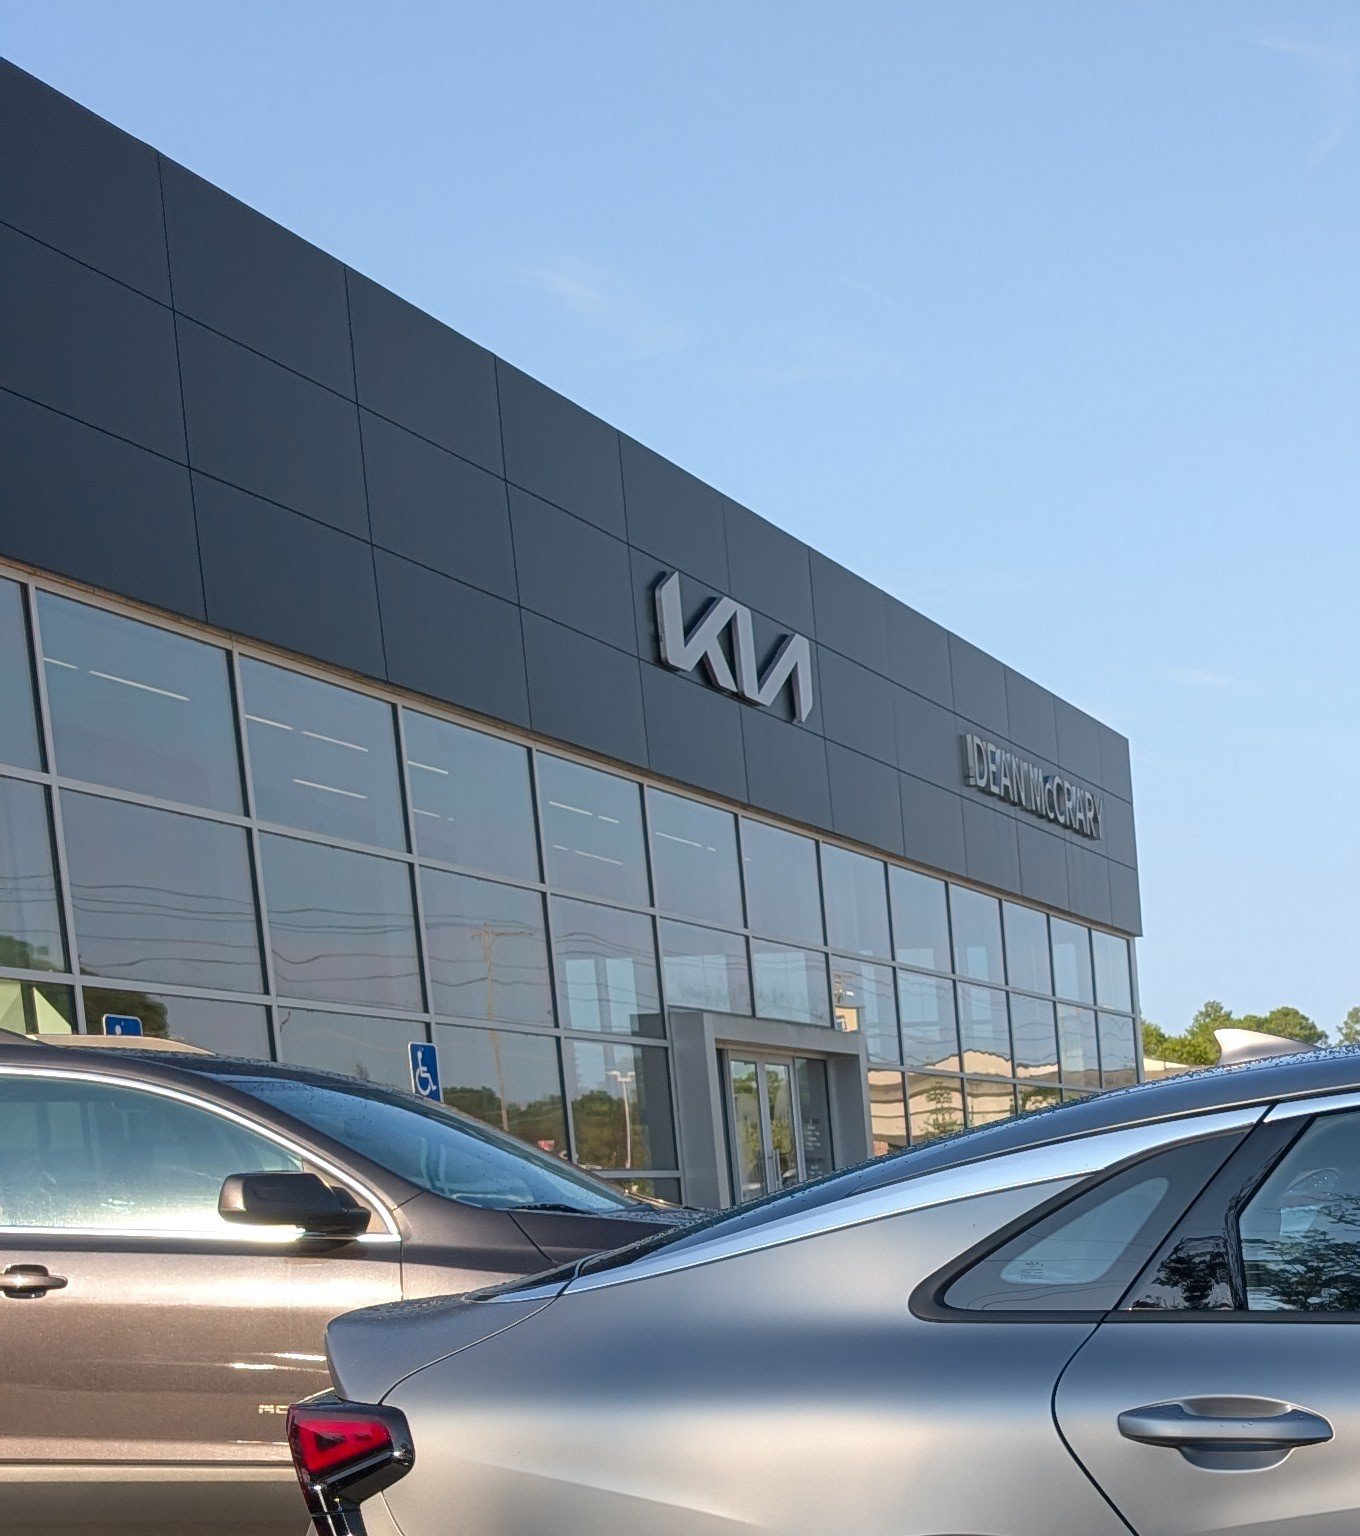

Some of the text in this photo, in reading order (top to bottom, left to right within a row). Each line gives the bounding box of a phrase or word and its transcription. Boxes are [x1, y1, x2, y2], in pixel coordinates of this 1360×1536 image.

[655, 571, 813, 723] KIA
[962, 734, 1103, 840] DEAN McCRARY
